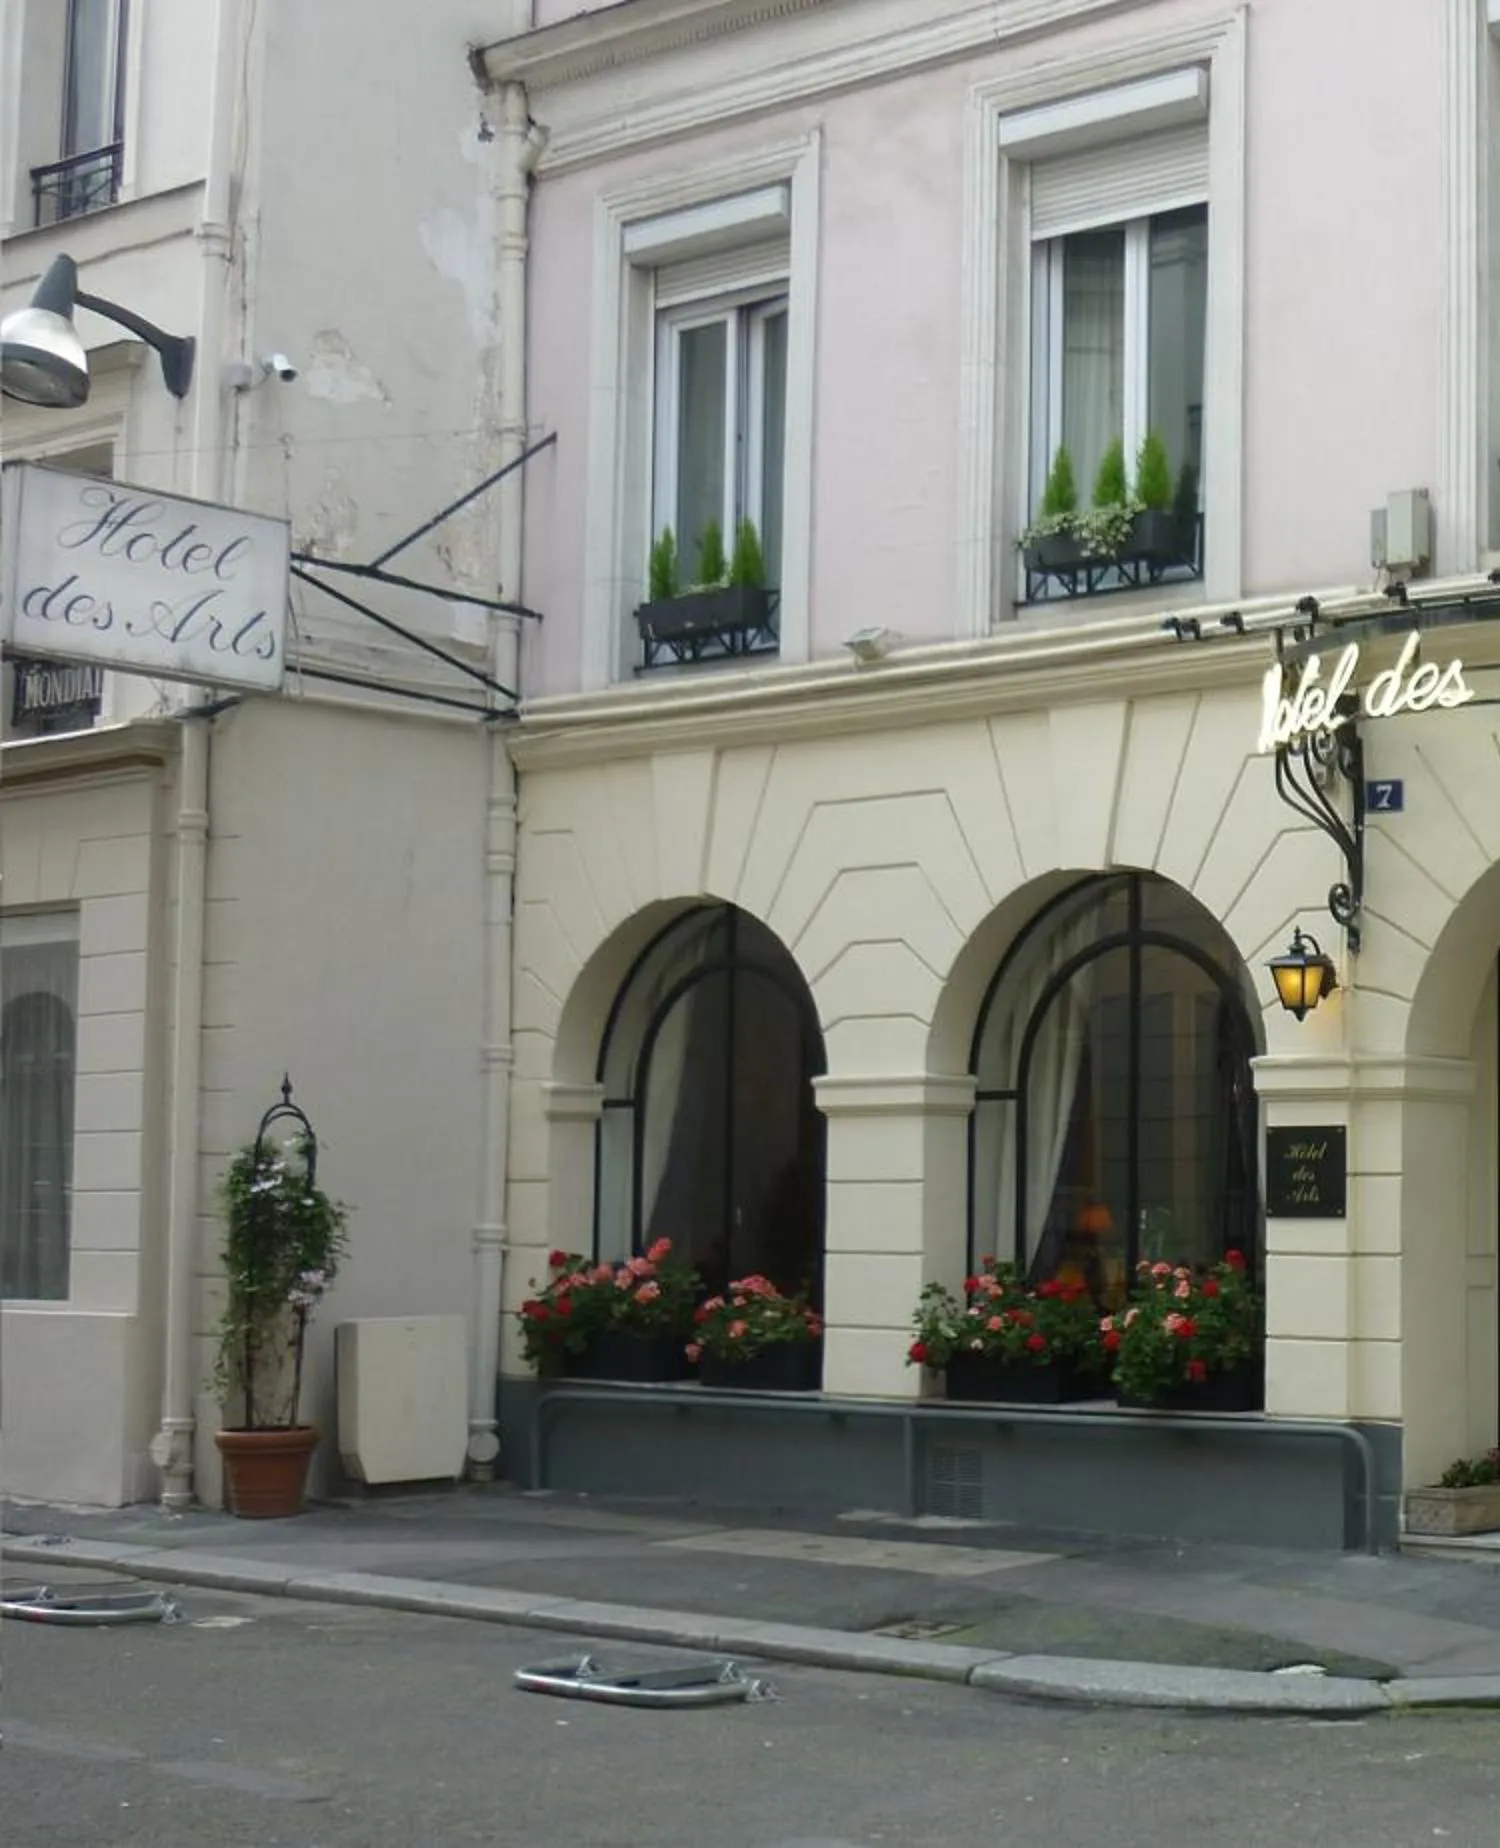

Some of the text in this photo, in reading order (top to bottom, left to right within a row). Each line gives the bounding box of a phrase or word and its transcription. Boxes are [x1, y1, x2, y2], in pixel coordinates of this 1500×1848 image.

[22, 575, 276, 660] des Arts
[1365, 630, 1475, 716] des
[1375, 783, 1393, 809] 7
